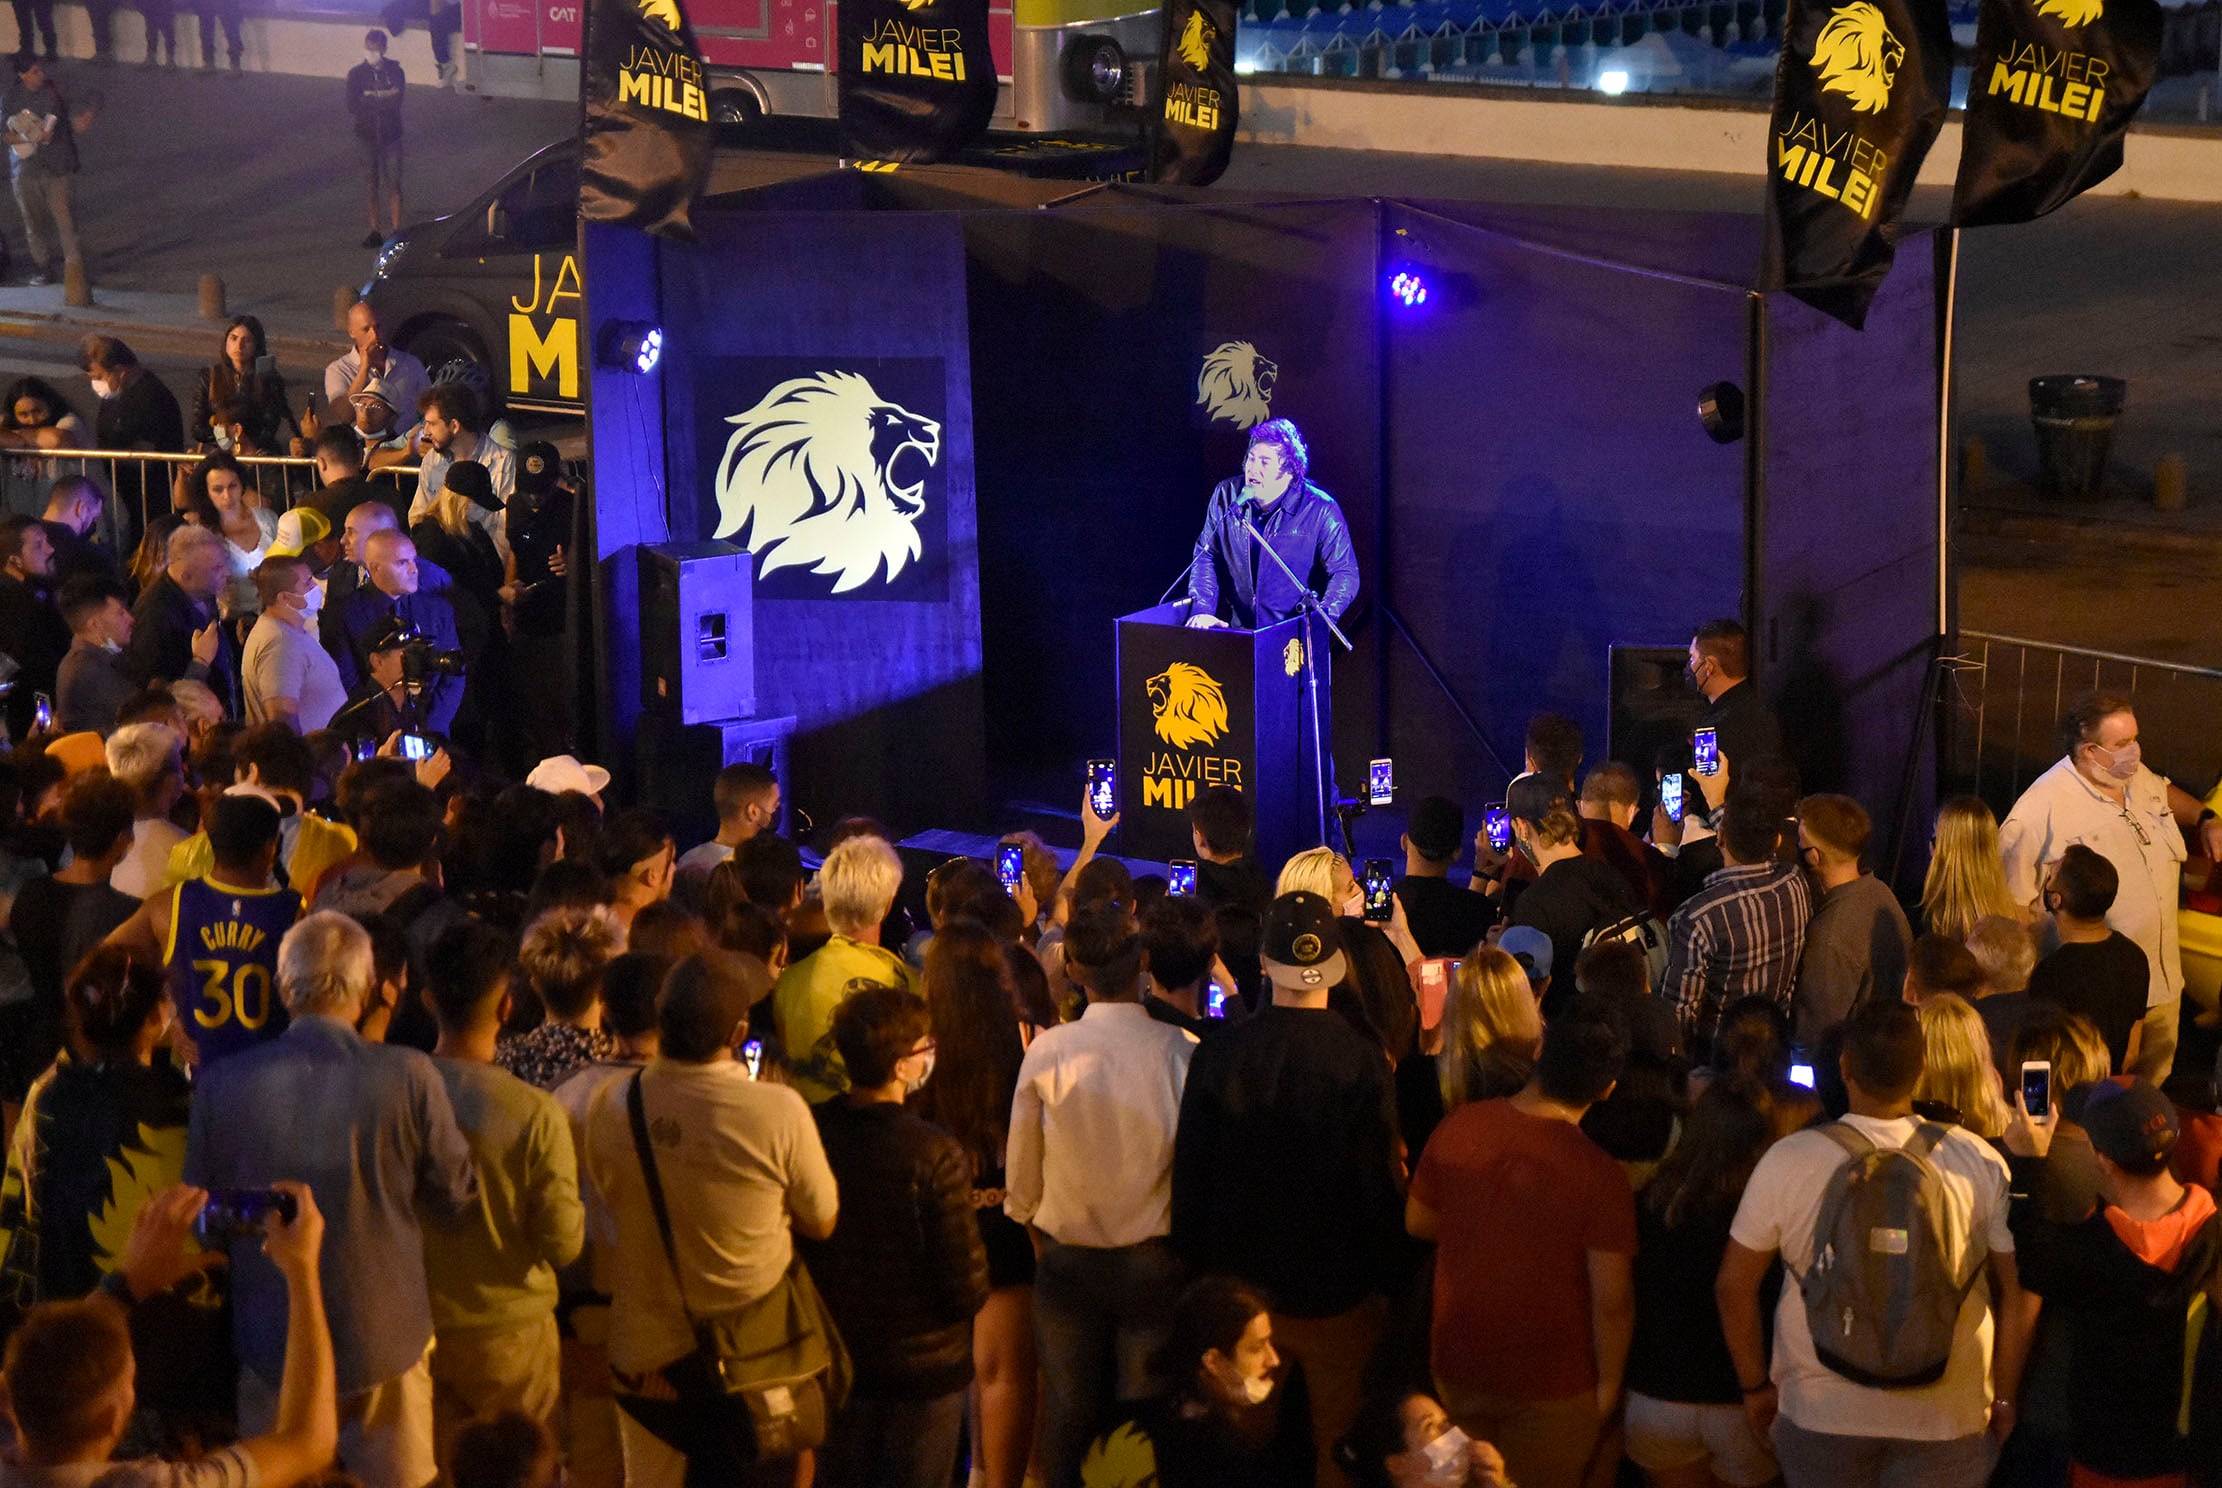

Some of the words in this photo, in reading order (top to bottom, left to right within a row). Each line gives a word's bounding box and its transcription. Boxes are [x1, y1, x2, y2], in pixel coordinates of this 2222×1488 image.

[549, 6, 577, 22] CAT
[862, 18, 962, 52] JAVIER
[620, 44, 704, 89] JAVIER
[862, 42, 966, 81] MILEI
[1998, 39, 2110, 88] JAVIER
[619, 69, 708, 122] MILEI
[1165, 97, 1218, 130] MILEI
[1167, 81, 1220, 108] JAVIER
[1988, 62, 2105, 123] MILEI
[1779, 111, 1888, 176] JAVIER
[1778, 136, 1879, 219] MILEI
[1143, 752, 1242, 783] JAVIER
[200, 920, 267, 951] CURRY
[192, 959, 271, 1030] 30
